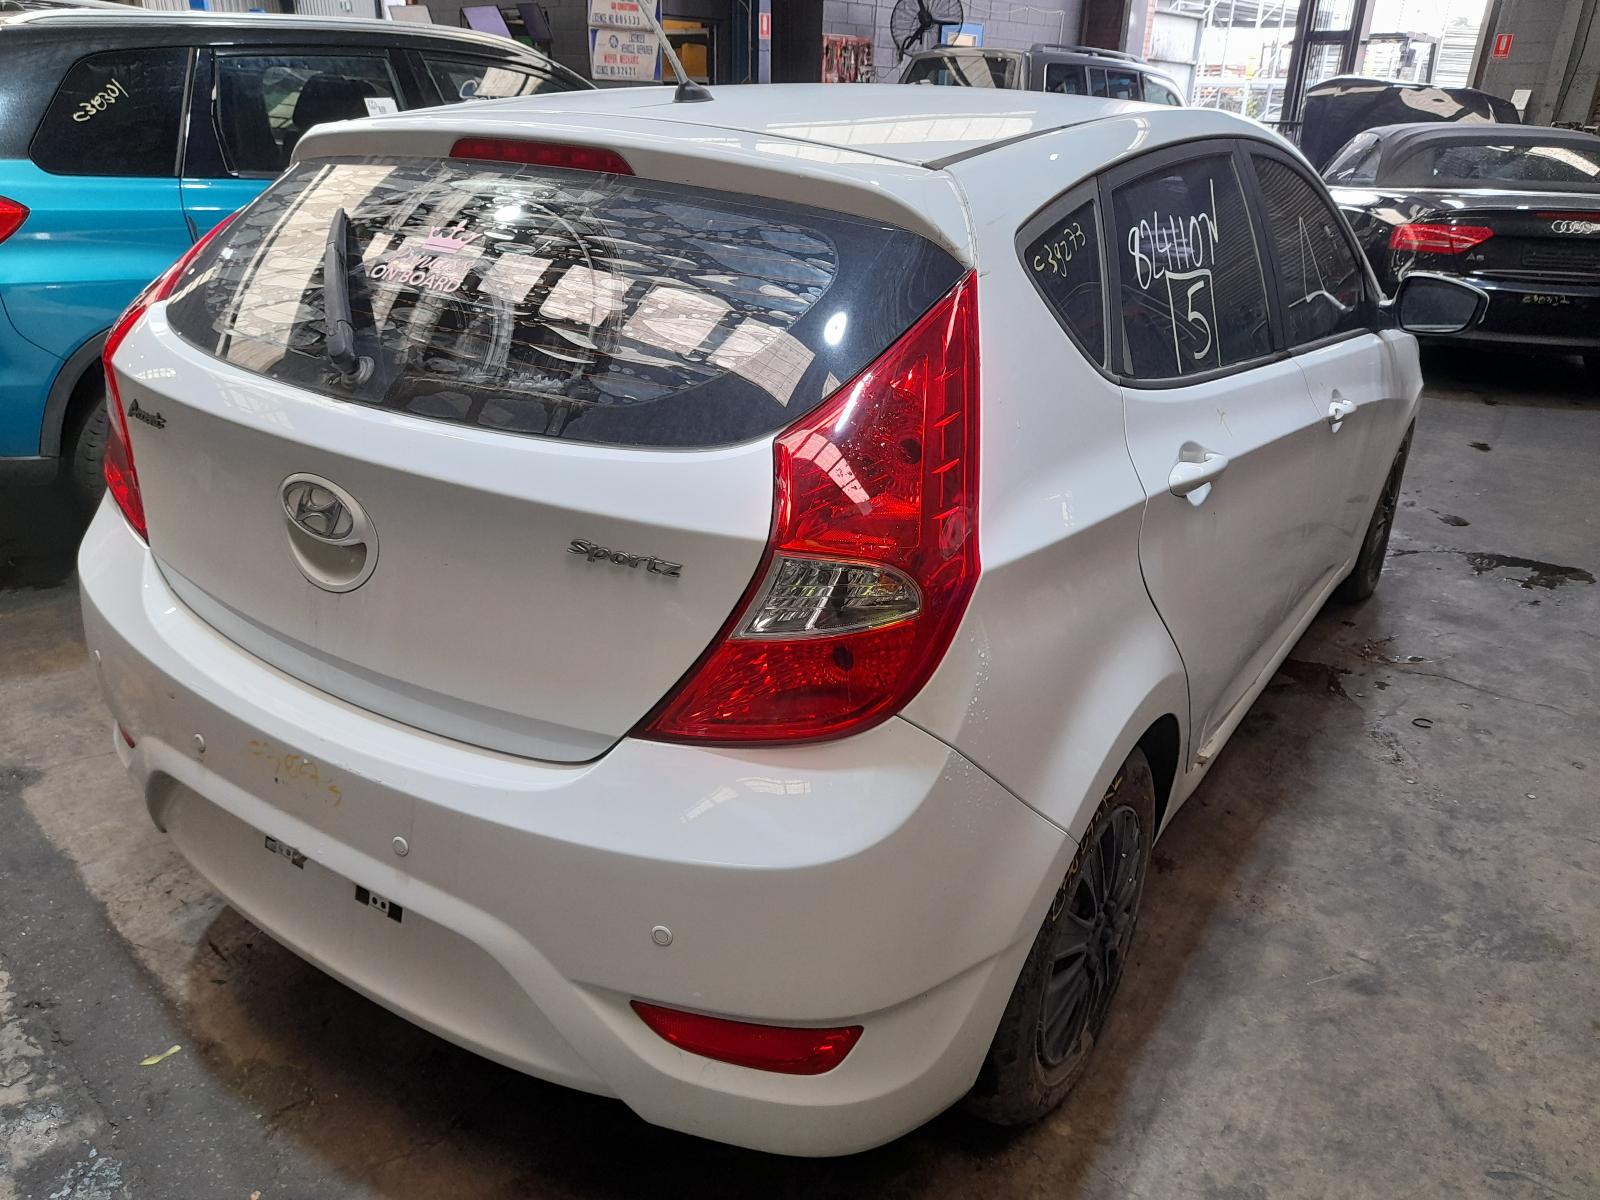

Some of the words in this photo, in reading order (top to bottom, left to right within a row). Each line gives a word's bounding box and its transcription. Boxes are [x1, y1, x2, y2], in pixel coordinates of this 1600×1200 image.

[370, 264, 399, 281] ON
[399, 271, 462, 293] BOARD
[1187, 280, 1212, 360] 5
[567, 539, 683, 578] Sportz
